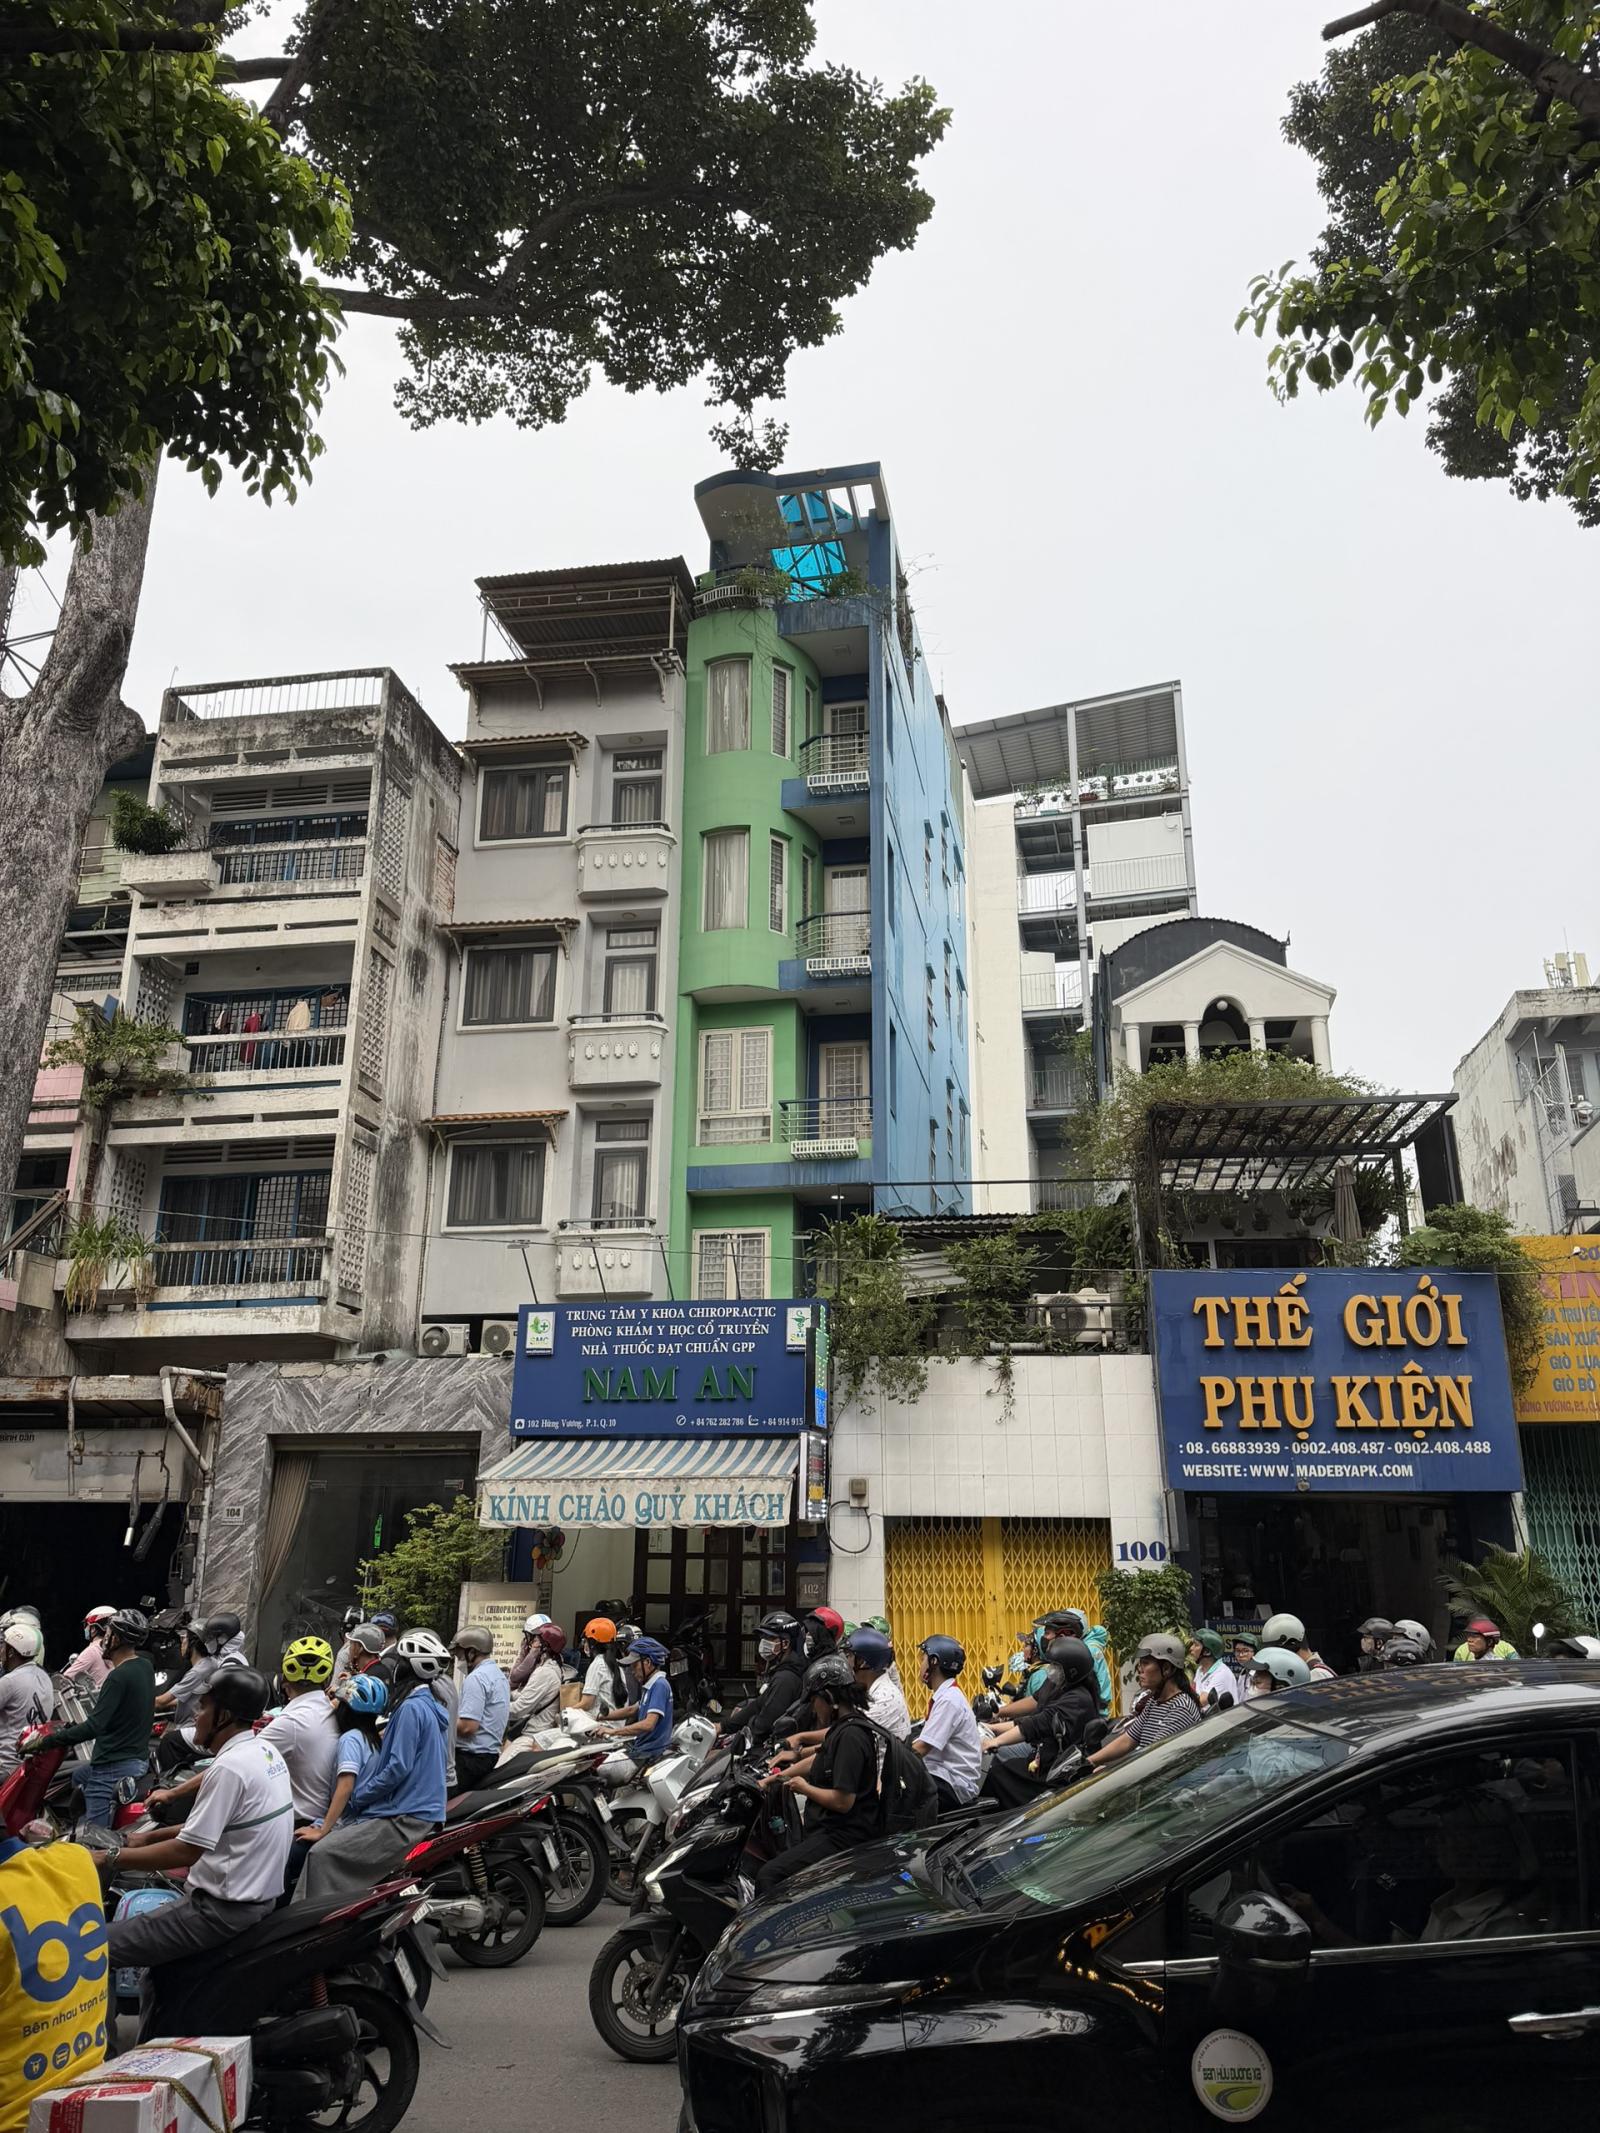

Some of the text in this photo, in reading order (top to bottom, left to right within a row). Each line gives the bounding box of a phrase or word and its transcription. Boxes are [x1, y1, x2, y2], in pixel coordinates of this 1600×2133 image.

[566, 1306, 776, 1320] TRUNG TÂM Y KHOA CHIROPRACTIC
[1193, 1272, 1468, 1348] THẾ GIỚI
[571, 1319, 769, 1337] PHÒNG KHÁM Y HỌC CỔ TRUYỀN
[1574, 1326, 1600, 1346] XUẤ
[582, 1338, 755, 1356] NHÀ THUỐC ĐẠT CHUẨN GPP
[582, 1364, 757, 1402] NAM AN
[1200, 1360, 1474, 1440] PHỤ KIỆN
[1183, 1464, 1248, 1477] WEBSITE:
[226, 1508, 240, 1517] 104
[489, 1487, 550, 1522] KÍNH
[558, 1487, 626, 1522] CHÀO
[695, 1486, 786, 1522] KHÁCH
[1116, 1541, 1166, 1561] 100
[804, 1584, 818, 1594] 102
[0, 1902, 108, 2002] be
[22, 2019, 49, 2038] Bên
[52, 2007, 77, 2027] nhau
[79, 1996, 98, 2012] trọn
